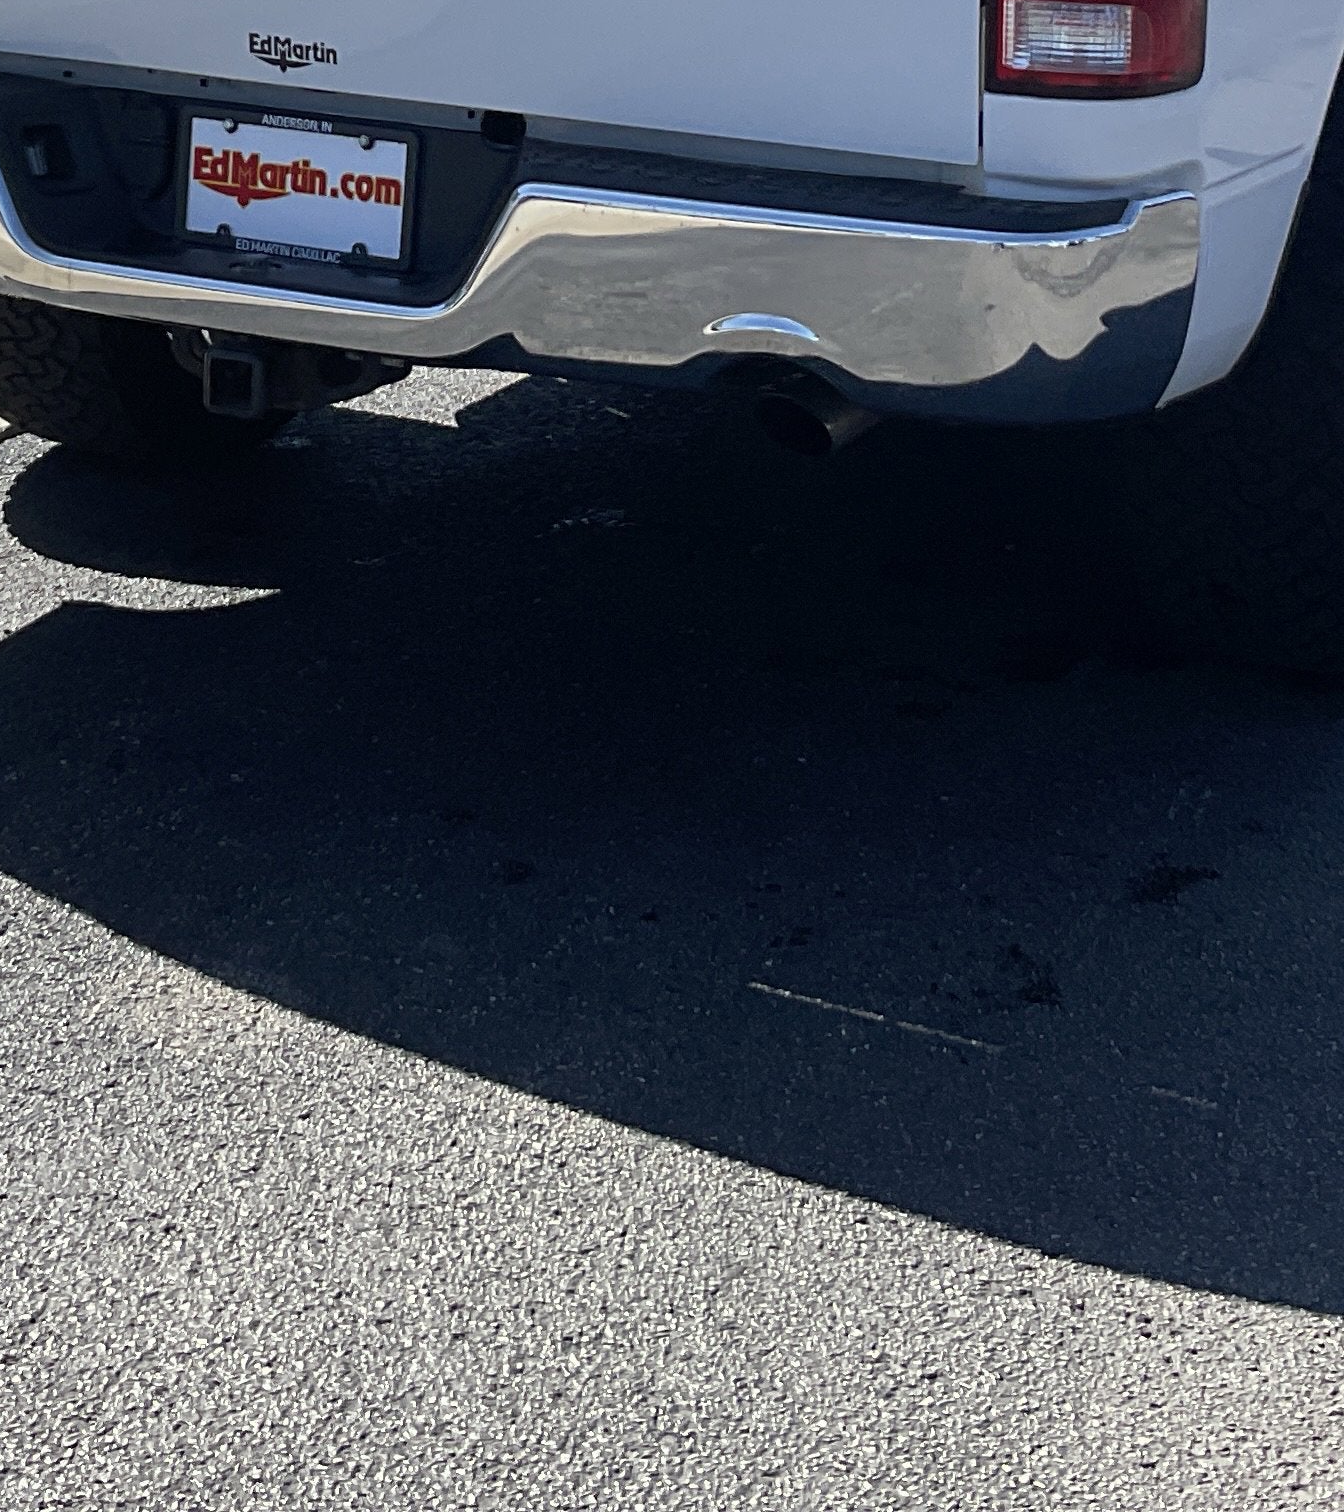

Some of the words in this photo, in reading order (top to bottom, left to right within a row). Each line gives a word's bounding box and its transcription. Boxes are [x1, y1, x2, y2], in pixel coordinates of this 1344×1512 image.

[320, 121, 333, 133] IN
[193, 146, 402, 206] EdMartin.com
[235, 237, 250, 251] ED
